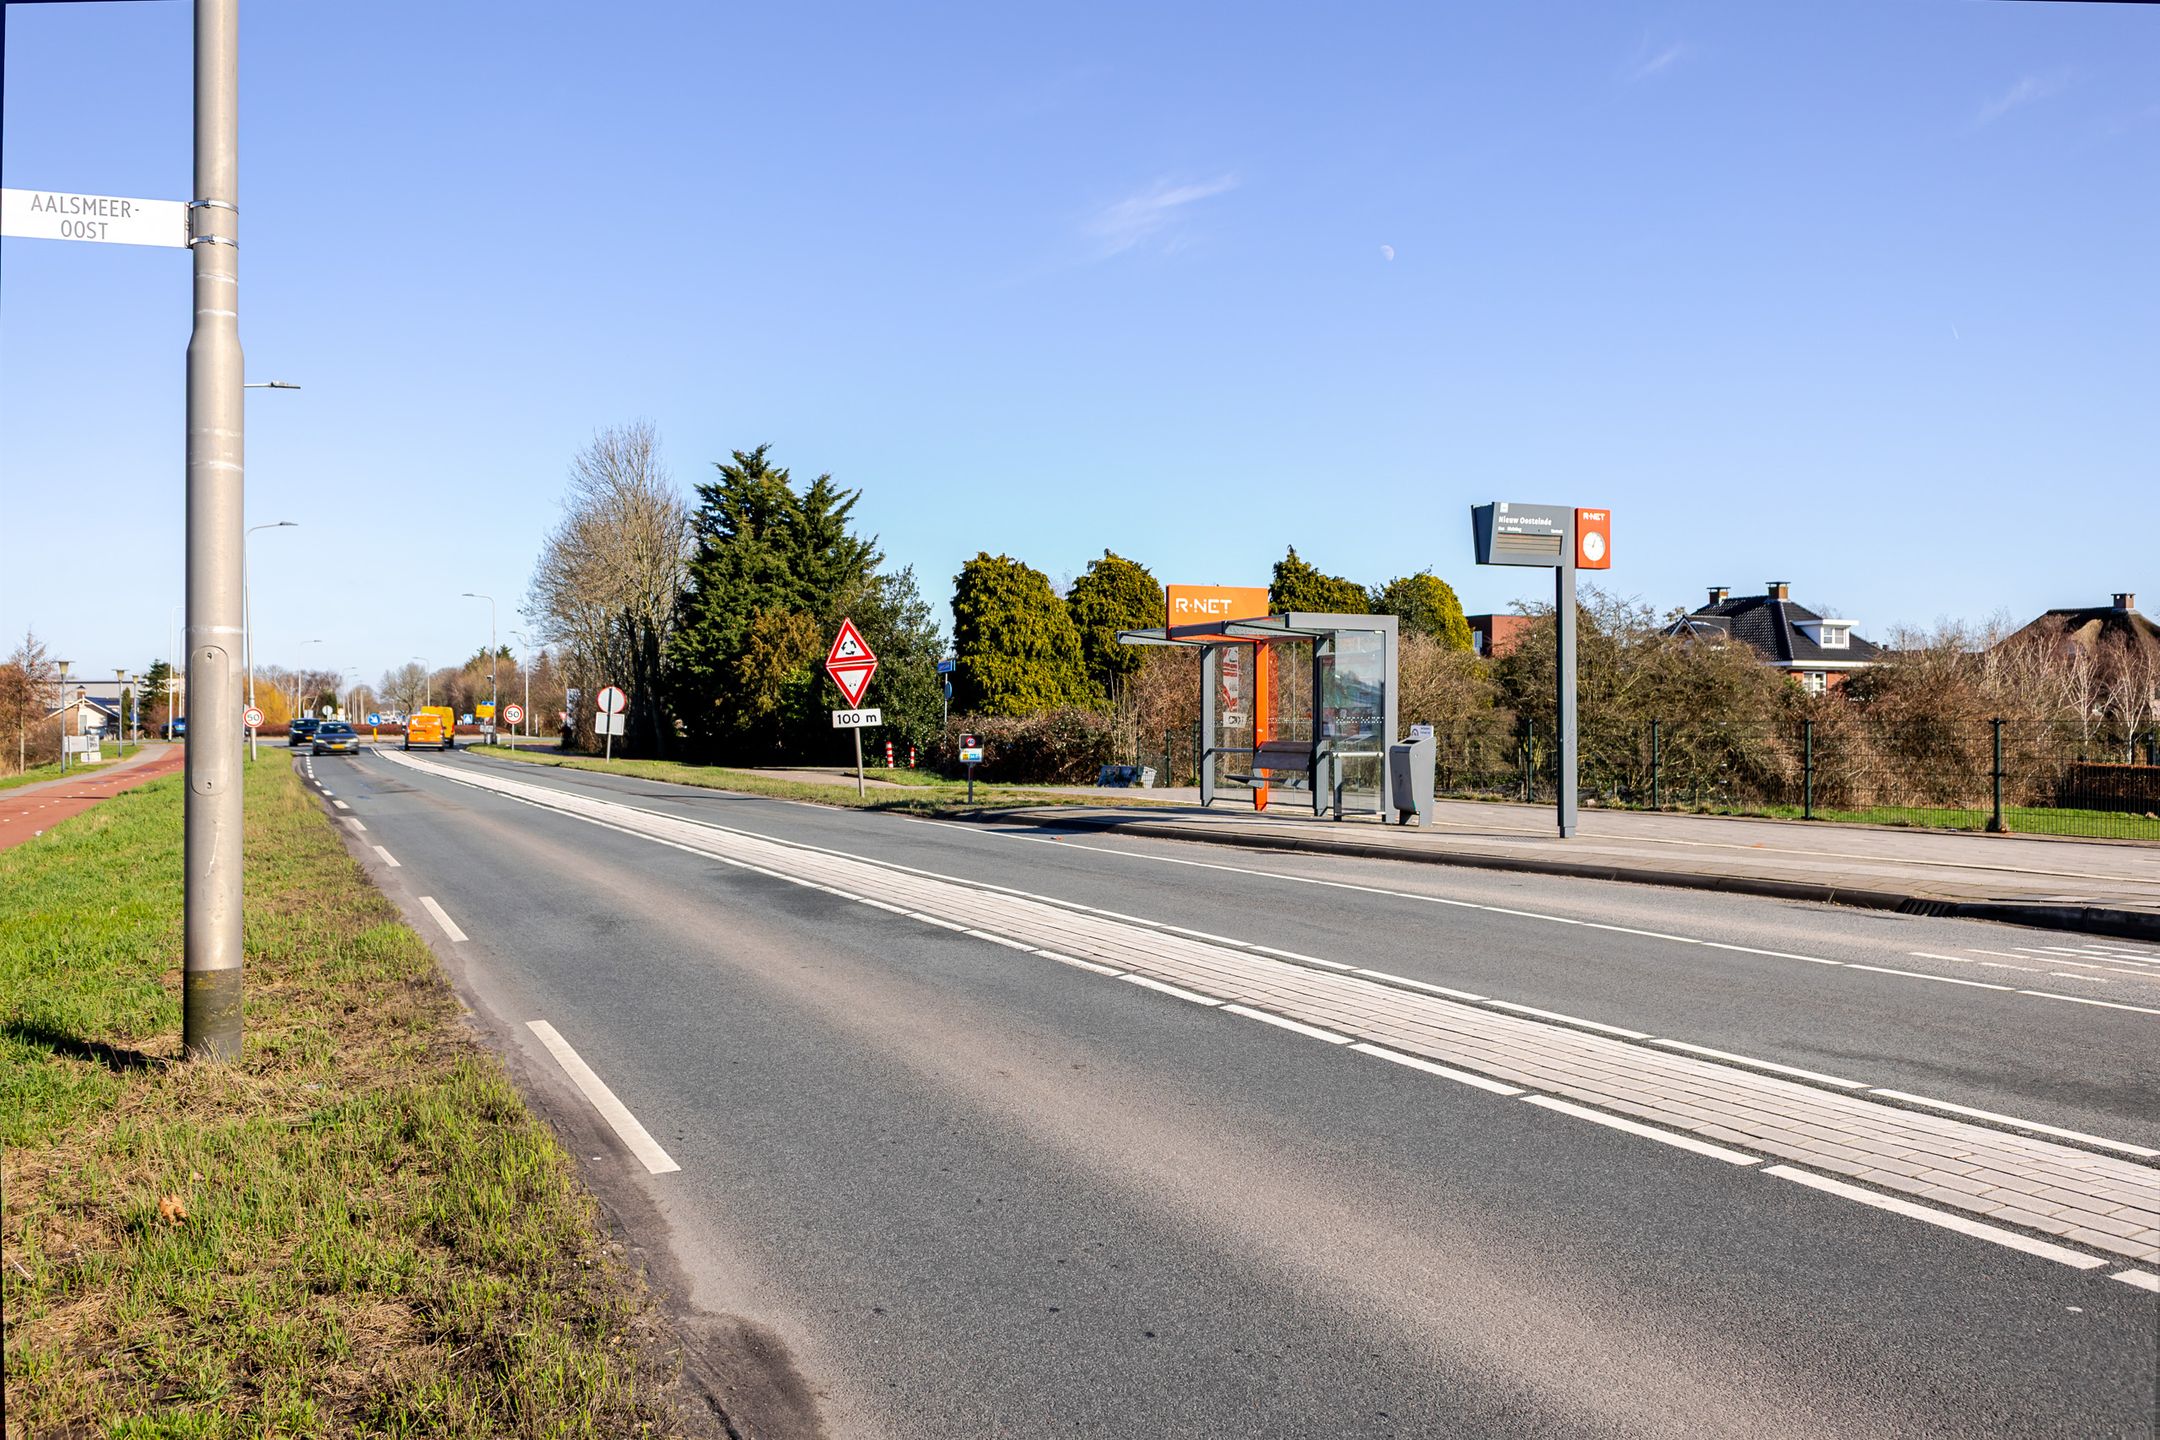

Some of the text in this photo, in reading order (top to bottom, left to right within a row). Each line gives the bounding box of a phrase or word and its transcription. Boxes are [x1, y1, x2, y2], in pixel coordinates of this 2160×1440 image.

[31, 194, 140, 218] AALSMEER-
[61, 220, 108, 240] OOST
[1498, 516, 1552, 526] Nieuw Oosteinde
[247, 714, 260, 722] 50
[507, 710, 520, 718] 50
[837, 713, 877, 724] 100 m
